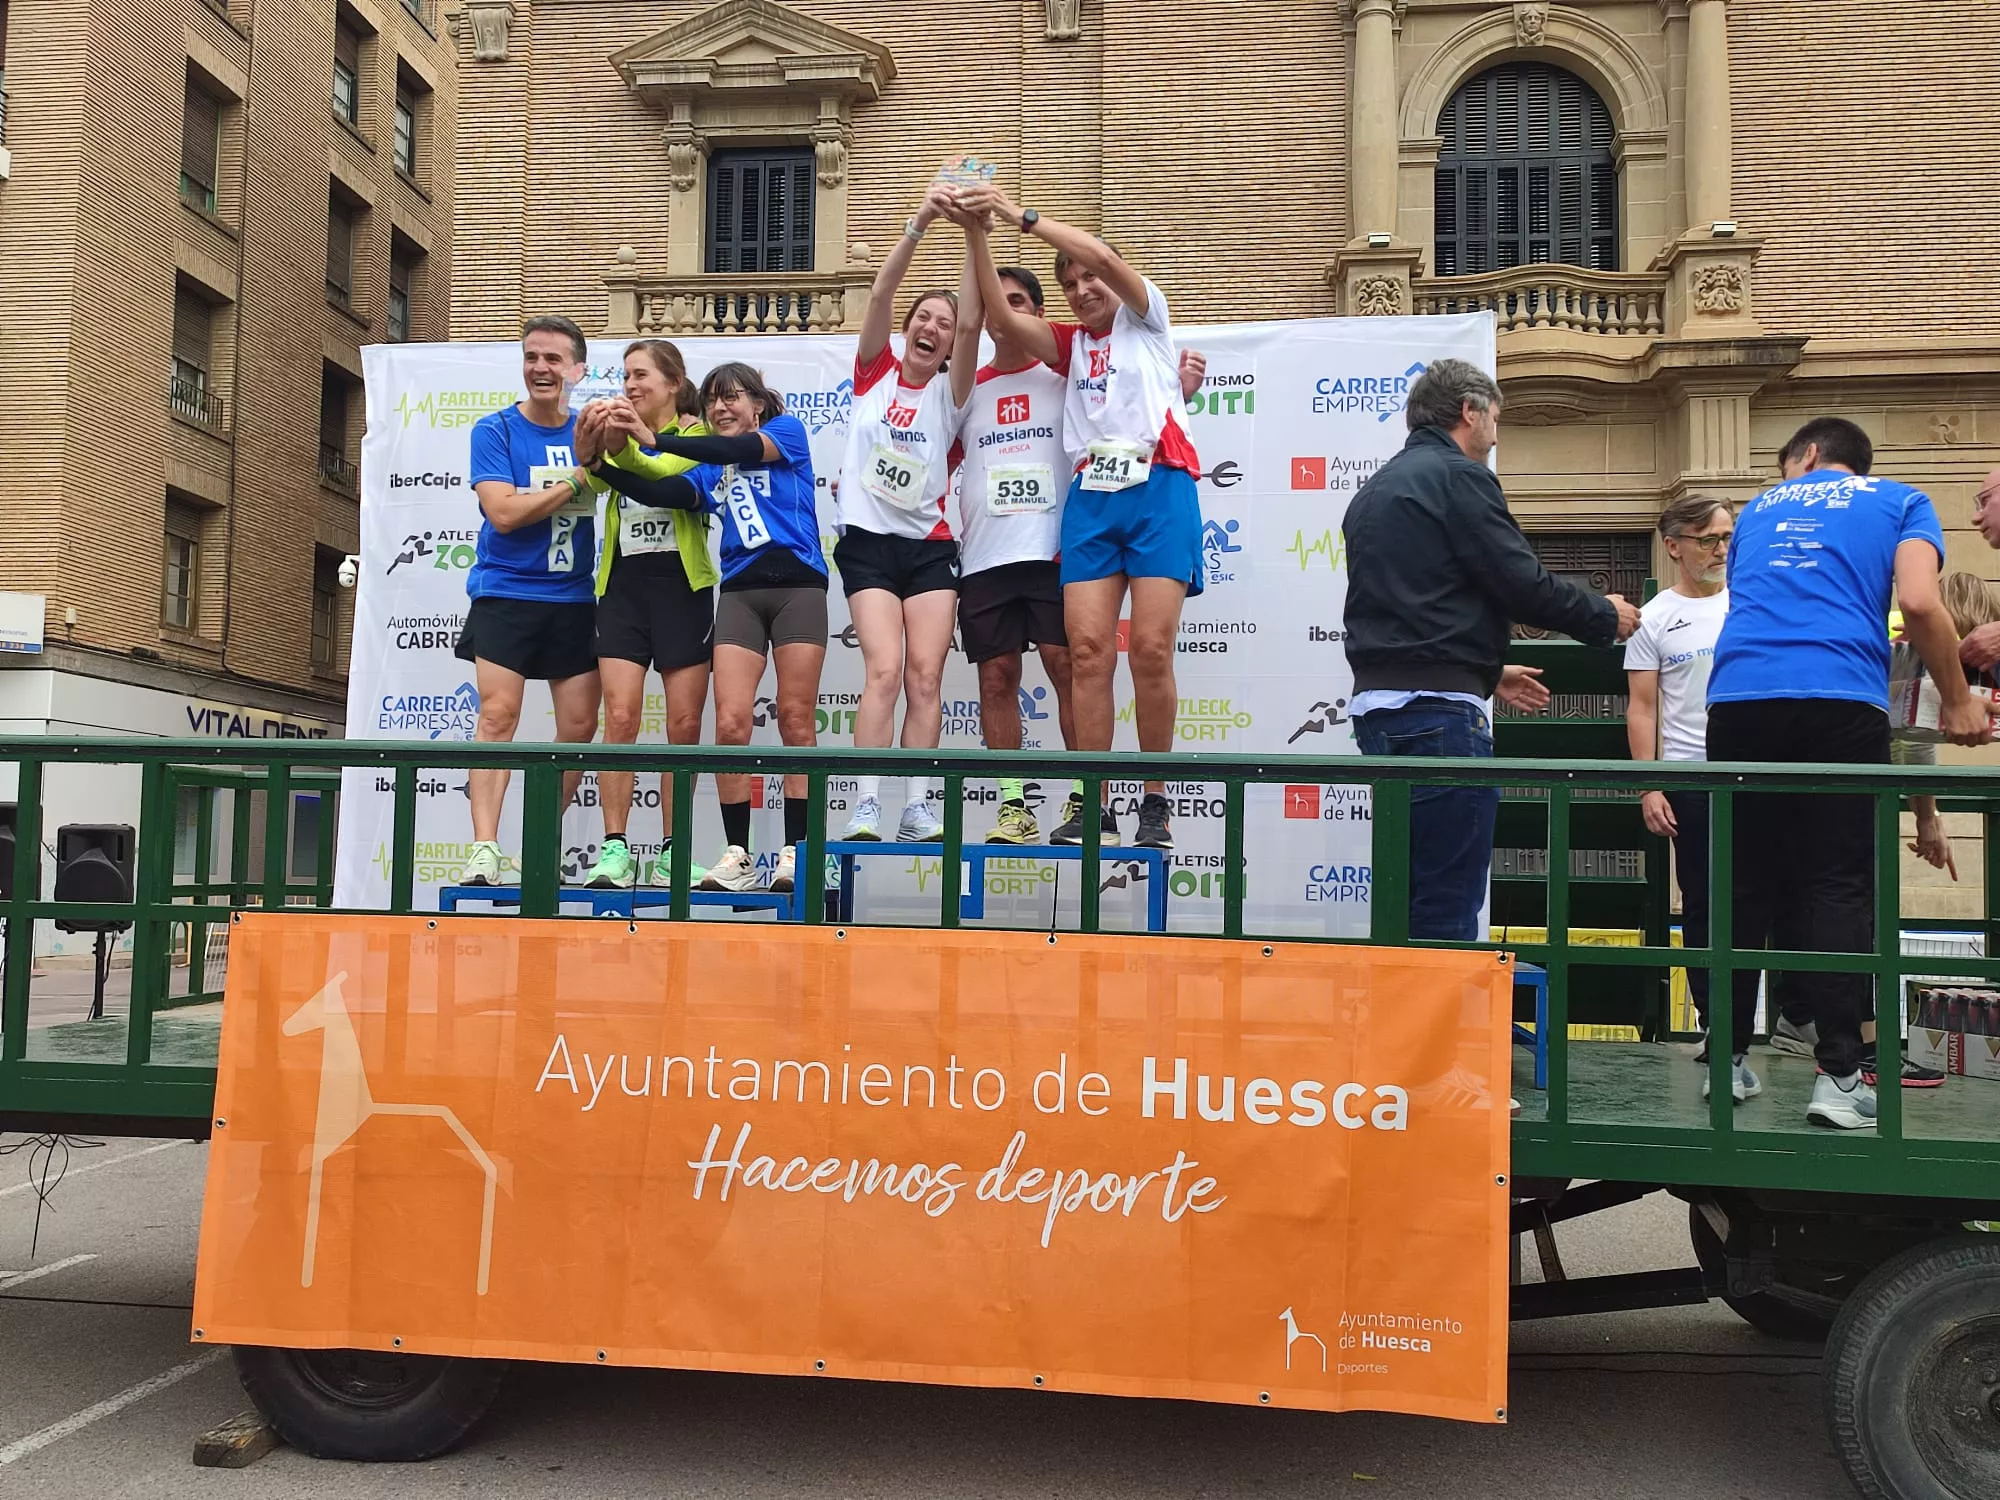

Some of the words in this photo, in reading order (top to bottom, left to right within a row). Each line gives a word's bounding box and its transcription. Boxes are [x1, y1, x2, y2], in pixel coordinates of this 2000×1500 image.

[1204, 374, 1255, 387] TISMO
[1316, 377, 1408, 395] CARRER
[438, 391, 518, 406] FARTLECK
[786, 392, 852, 408] RRERA
[1312, 395, 1406, 414] EMPRES
[978, 426, 1054, 448] salesianos
[998, 443, 1032, 455] HUESCA
[875, 459, 911, 488] 540
[1093, 456, 1130, 476] 541
[390, 472, 462, 490] iberCaja
[883, 479, 897, 492] EVA
[997, 479, 1040, 498] 539
[1330, 475, 1350, 490] de
[1762, 479, 1854, 500] CARRERA
[994, 498, 1009, 506] GIL
[1011, 496, 1049, 505] MANUEL
[1754, 488, 1855, 513] EMPRESAS
[631, 520, 671, 539] 507
[387, 613, 468, 629] Automóvile
[1178, 619, 1257, 634] tamiento
[1309, 626, 1347, 642] iber
[1174, 640, 1228, 653] uesca
[382, 695, 473, 712] CARRERA
[818, 693, 862, 705] ETISM
[1177, 699, 1232, 716] TLECK
[378, 713, 475, 730] EMPRESAS
[1177, 724, 1232, 741] ORT
[1324, 807, 1345, 821] de
[415, 842, 474, 859] FARTLE
[1309, 865, 1372, 883] CARR
[988, 877, 1039, 895] ORT
[1305, 884, 1369, 903] EMPR
[535, 1034, 1005, 1112] Ayuntamiento
[1033, 1052, 1112, 1116] de
[1141, 1056, 1410, 1132] Huesca
[687, 1121, 967, 1219] Hacemos
[975, 1130, 1228, 1249] deporte
[1338, 1310, 1463, 1335] Ayuntamiento
[1339, 1331, 1356, 1350] de
[1361, 1331, 1432, 1353] Huesca
